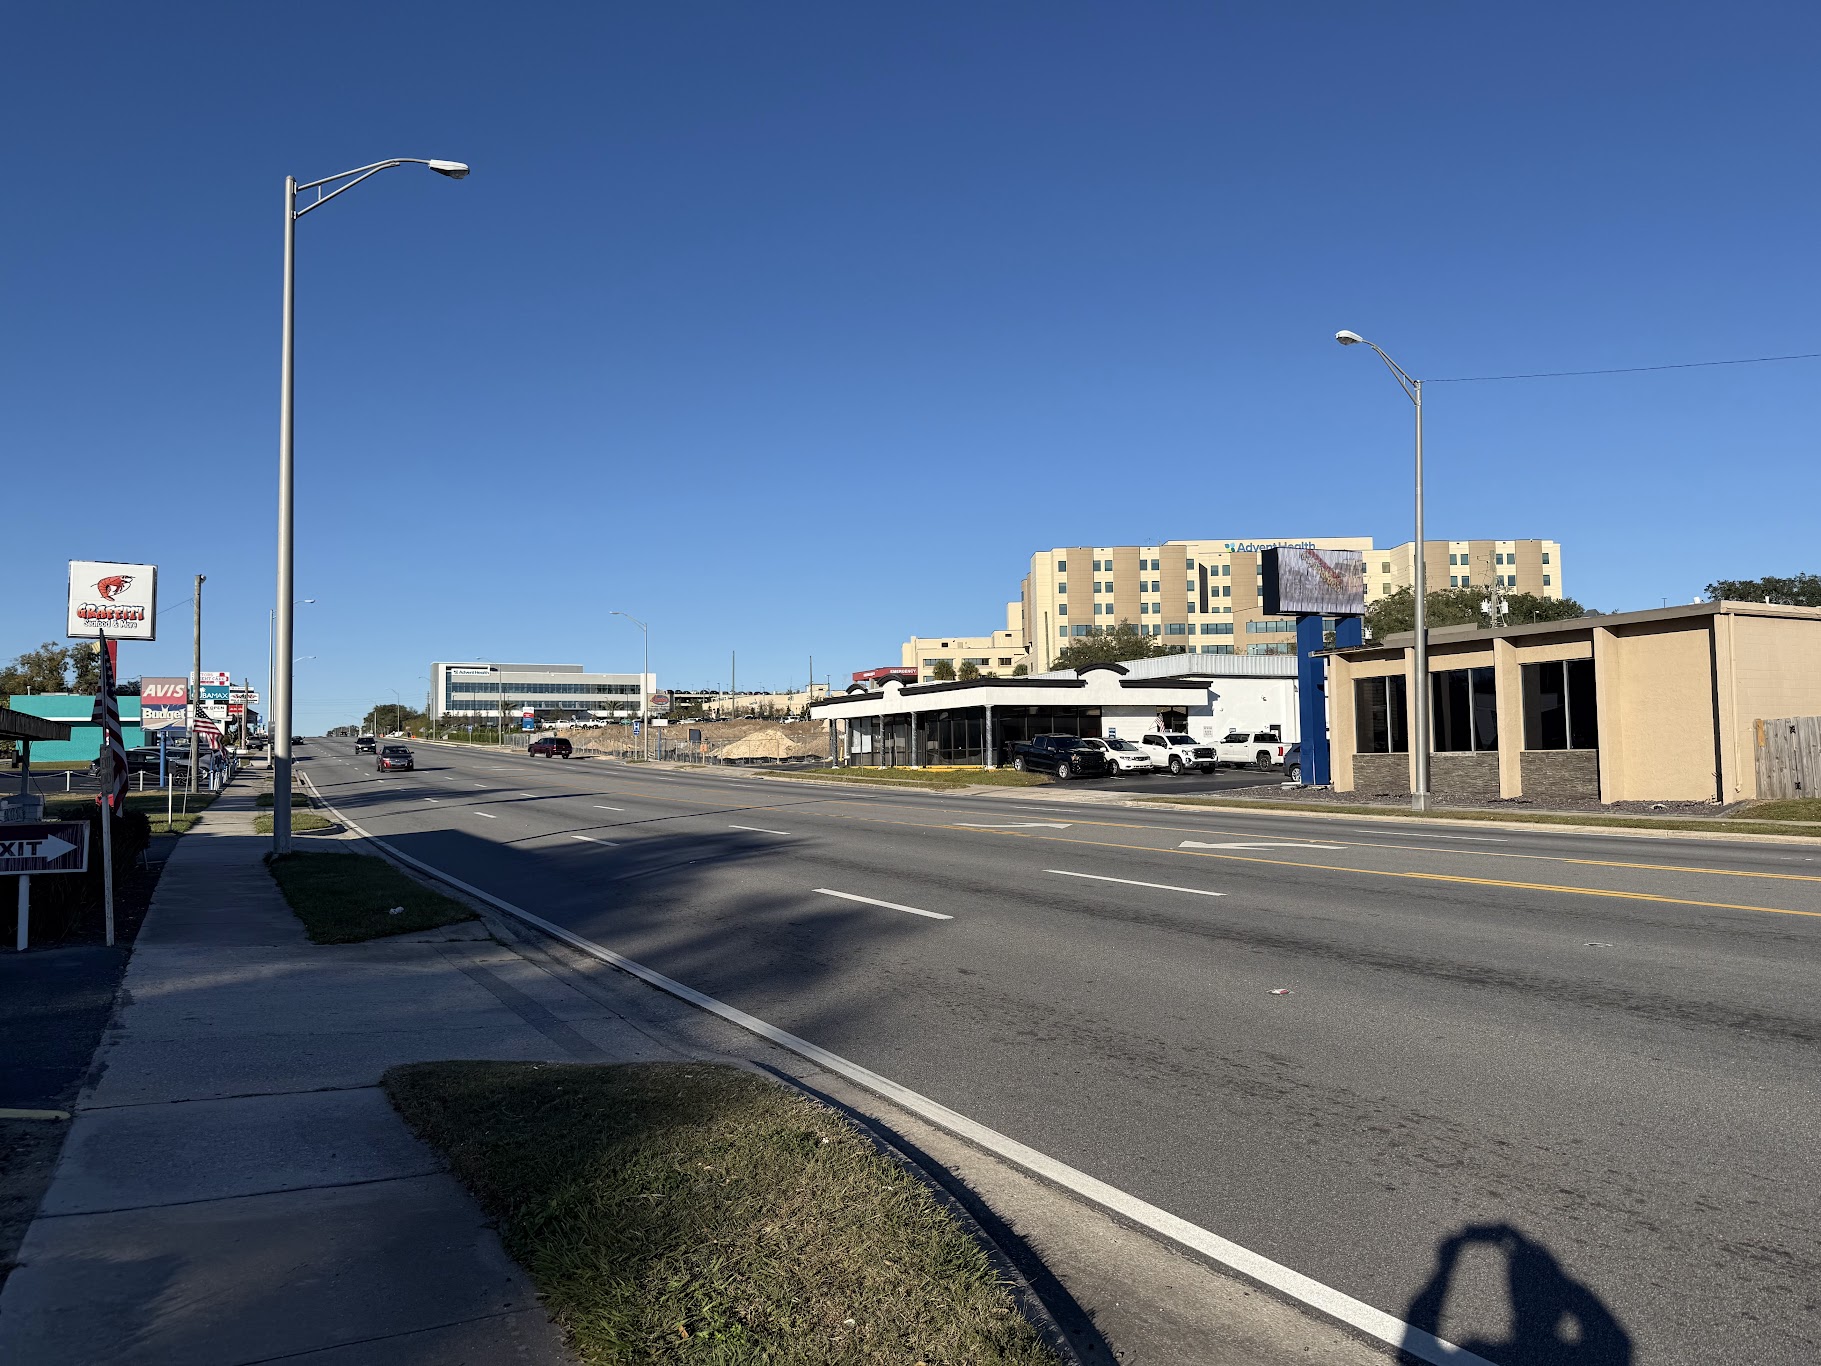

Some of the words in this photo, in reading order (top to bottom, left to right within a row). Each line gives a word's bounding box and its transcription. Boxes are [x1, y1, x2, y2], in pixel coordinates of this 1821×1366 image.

[77, 602, 145, 621] GRAFFITI
[84, 620, 111, 628] Seafood
[112, 620, 119, 628] &
[120, 620, 138, 629] More
[142, 684, 186, 698] AVIS
[141, 705, 186, 720] Budget
[0, 841, 42, 857] XIT
